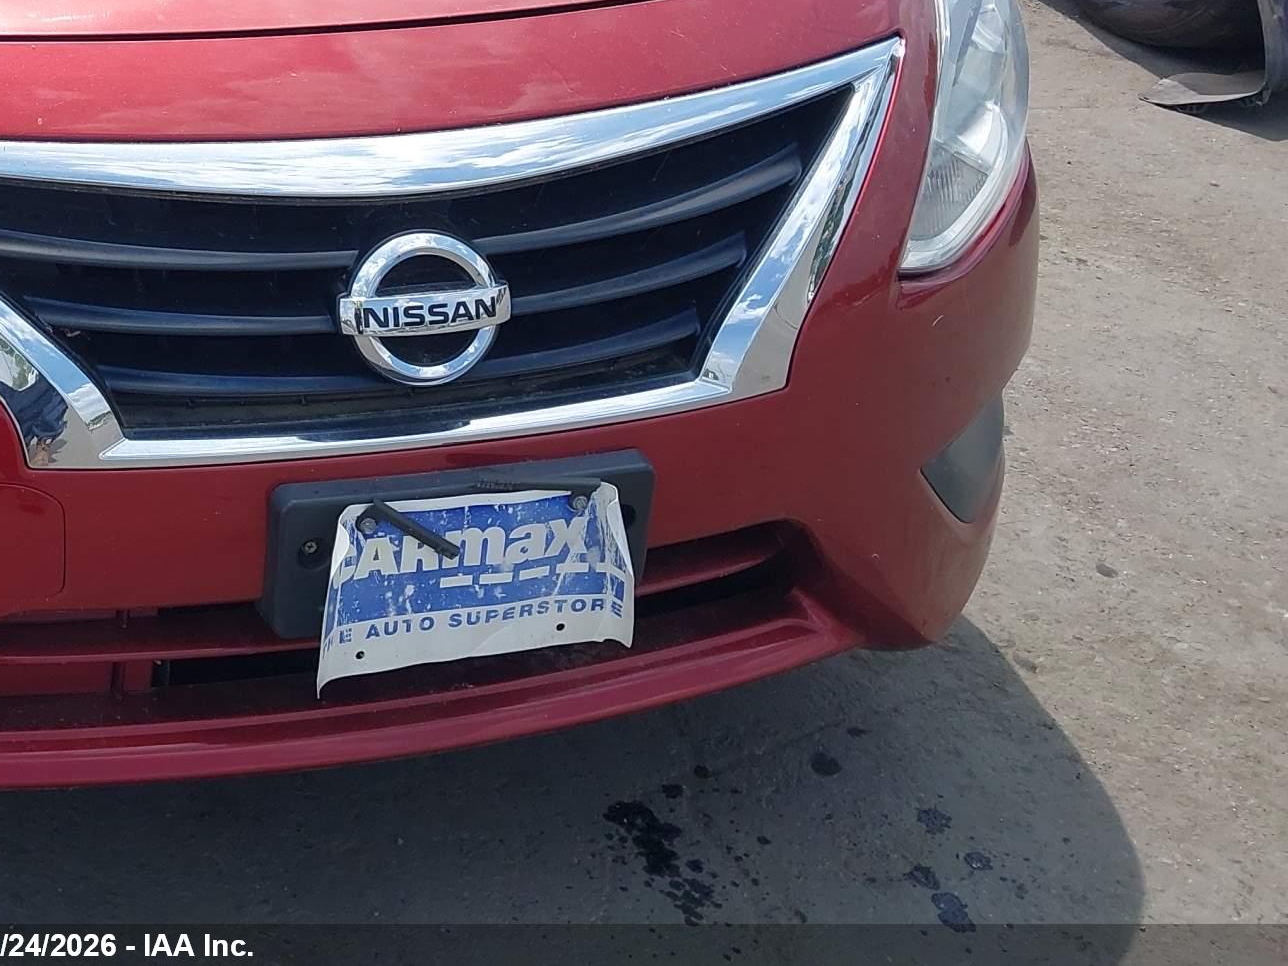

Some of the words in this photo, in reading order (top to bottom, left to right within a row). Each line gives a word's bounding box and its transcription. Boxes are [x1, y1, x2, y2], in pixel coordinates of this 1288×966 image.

[362, 295, 497, 329] NISSAN
[365, 616, 435, 640] AUTO
[447, 598, 623, 628] SUPERSTORE
